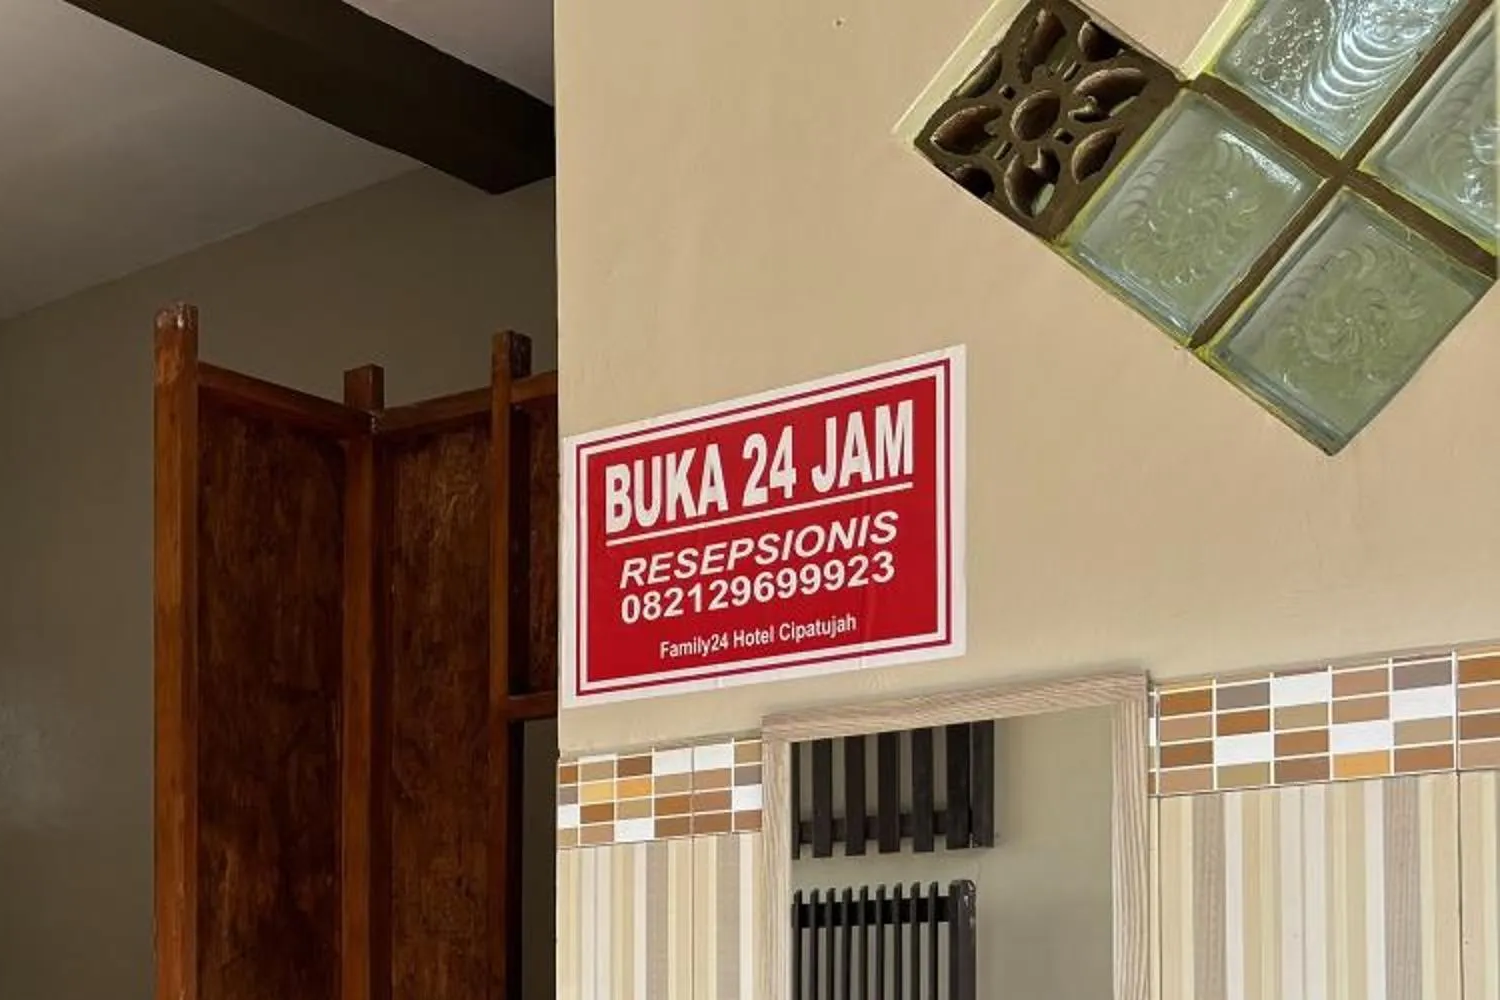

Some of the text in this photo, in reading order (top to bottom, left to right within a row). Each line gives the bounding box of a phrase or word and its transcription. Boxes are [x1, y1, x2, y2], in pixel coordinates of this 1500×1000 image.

[605, 399, 913, 534] BUKA 24 JAM
[619, 511, 898, 589] RESEPSIONIS
[620, 551, 895, 624] 082129699923
[660, 613, 857, 660] Family24 Hotel Cipatujah
